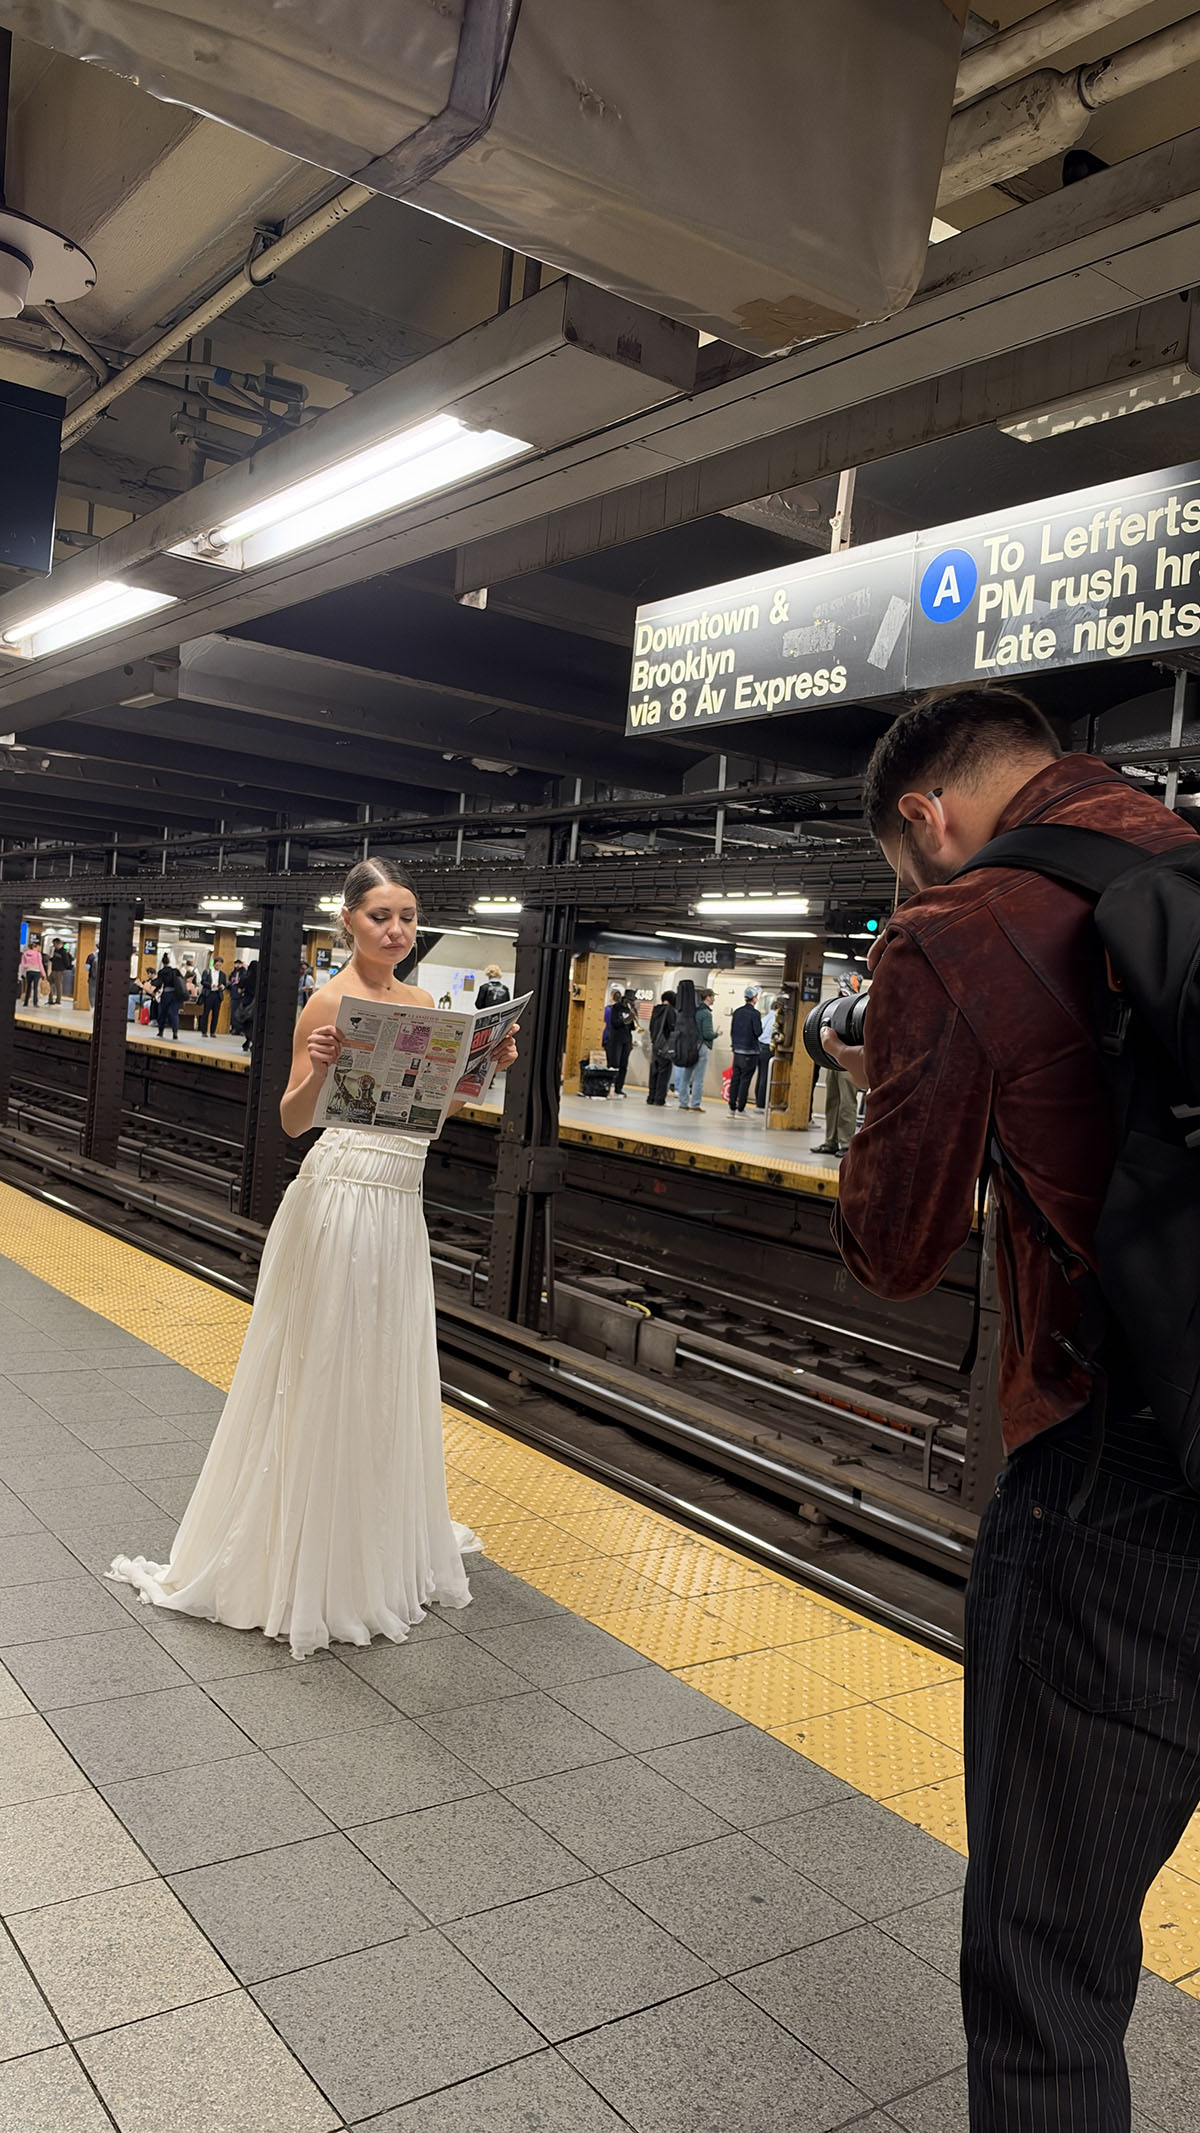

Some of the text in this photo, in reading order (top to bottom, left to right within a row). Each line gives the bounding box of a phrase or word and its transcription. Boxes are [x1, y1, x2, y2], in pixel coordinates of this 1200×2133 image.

[983, 496, 1200, 576] To Lefferts
[933, 565, 961, 608] A
[977, 547, 1200, 624] PM rush hr
[635, 588, 789, 656] Downtown &
[974, 598, 1200, 670] Late nights
[630, 665, 848, 728] via 8 Av Express
[631, 646, 736, 692] Brooklyn
[693, 948, 718, 964] reet
[805, 976, 815, 988] 14
